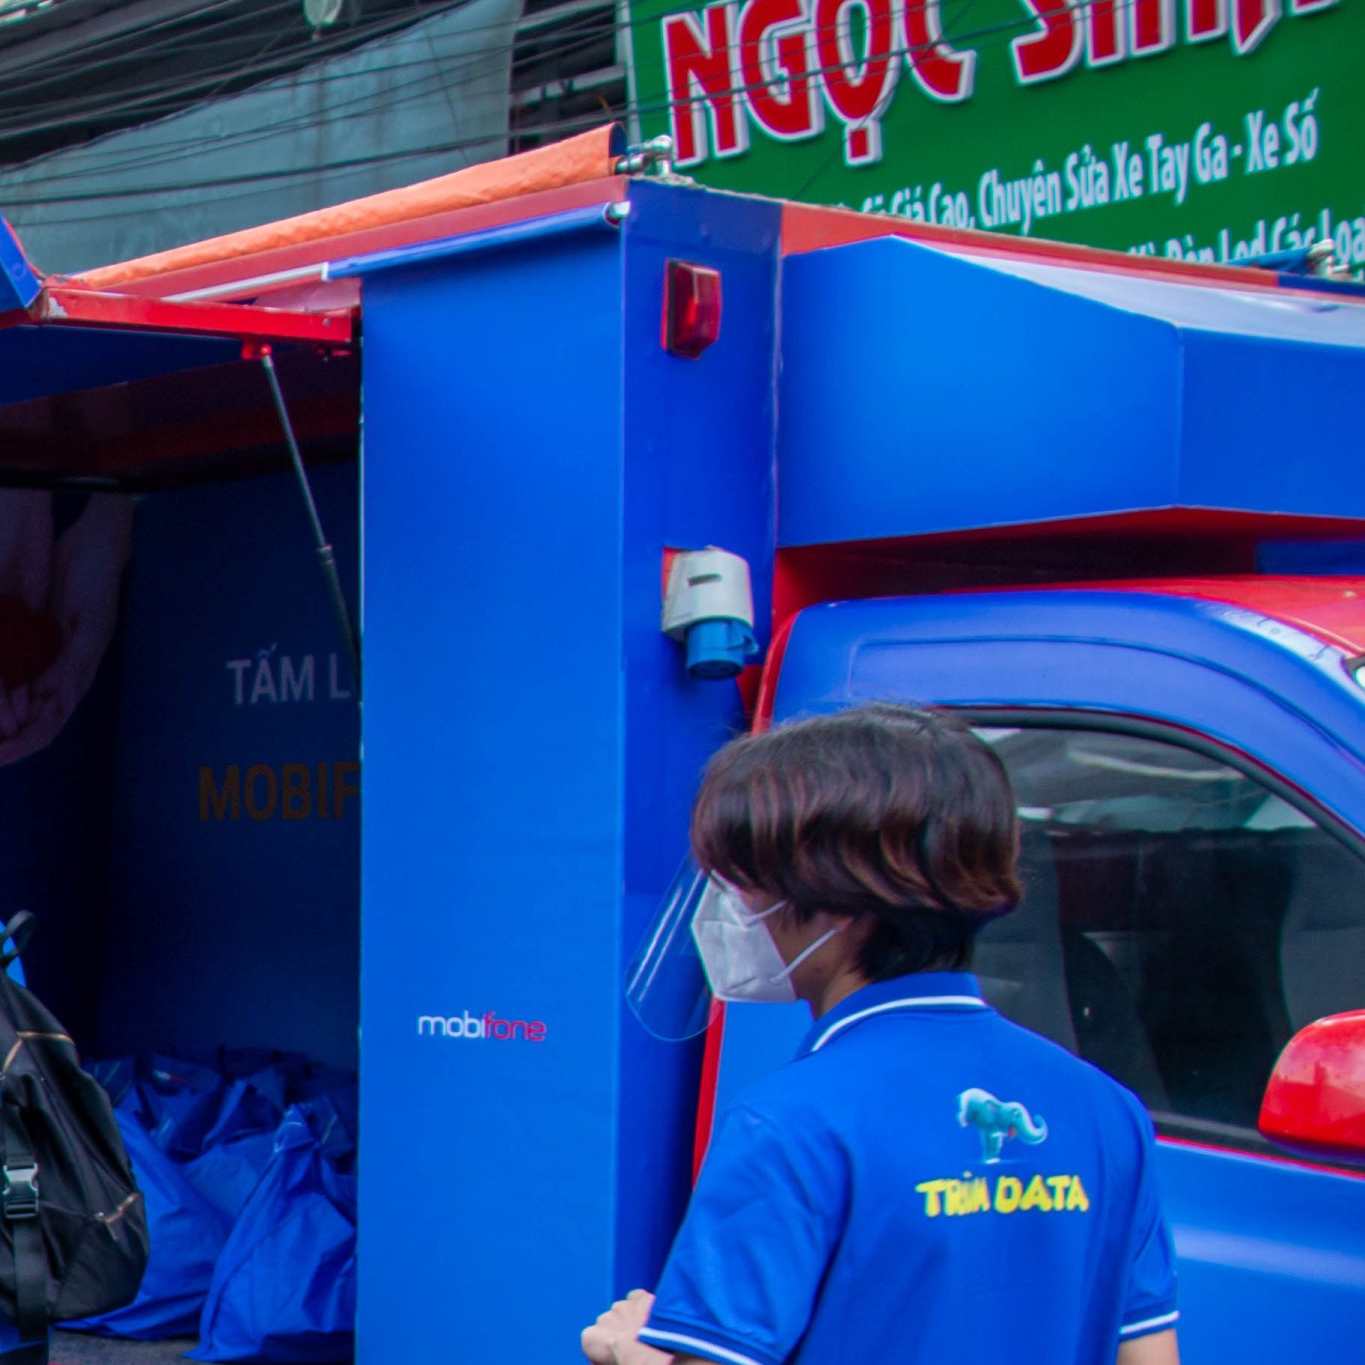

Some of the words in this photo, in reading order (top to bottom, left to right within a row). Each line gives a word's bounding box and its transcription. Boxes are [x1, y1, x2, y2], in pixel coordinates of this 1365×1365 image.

[661, 0, 977, 168] NGỌC
[978, 158, 1062, 236] Chuyên
[1064, 144, 1110, 212] Sửa
[1112, 141, 1143, 201] Xe
[1146, 133, 1190, 206] Tay
[1194, 122, 1229, 184] Ga
[1244, 110, 1280, 175] Xe
[1284, 86, 1320, 166] Số
[227, 641, 315, 705] TẤM
[198, 759, 361, 822] MOBIF
[418, 1010, 547, 1042] mobifone
[994, 1174, 1090, 1215] DATA
